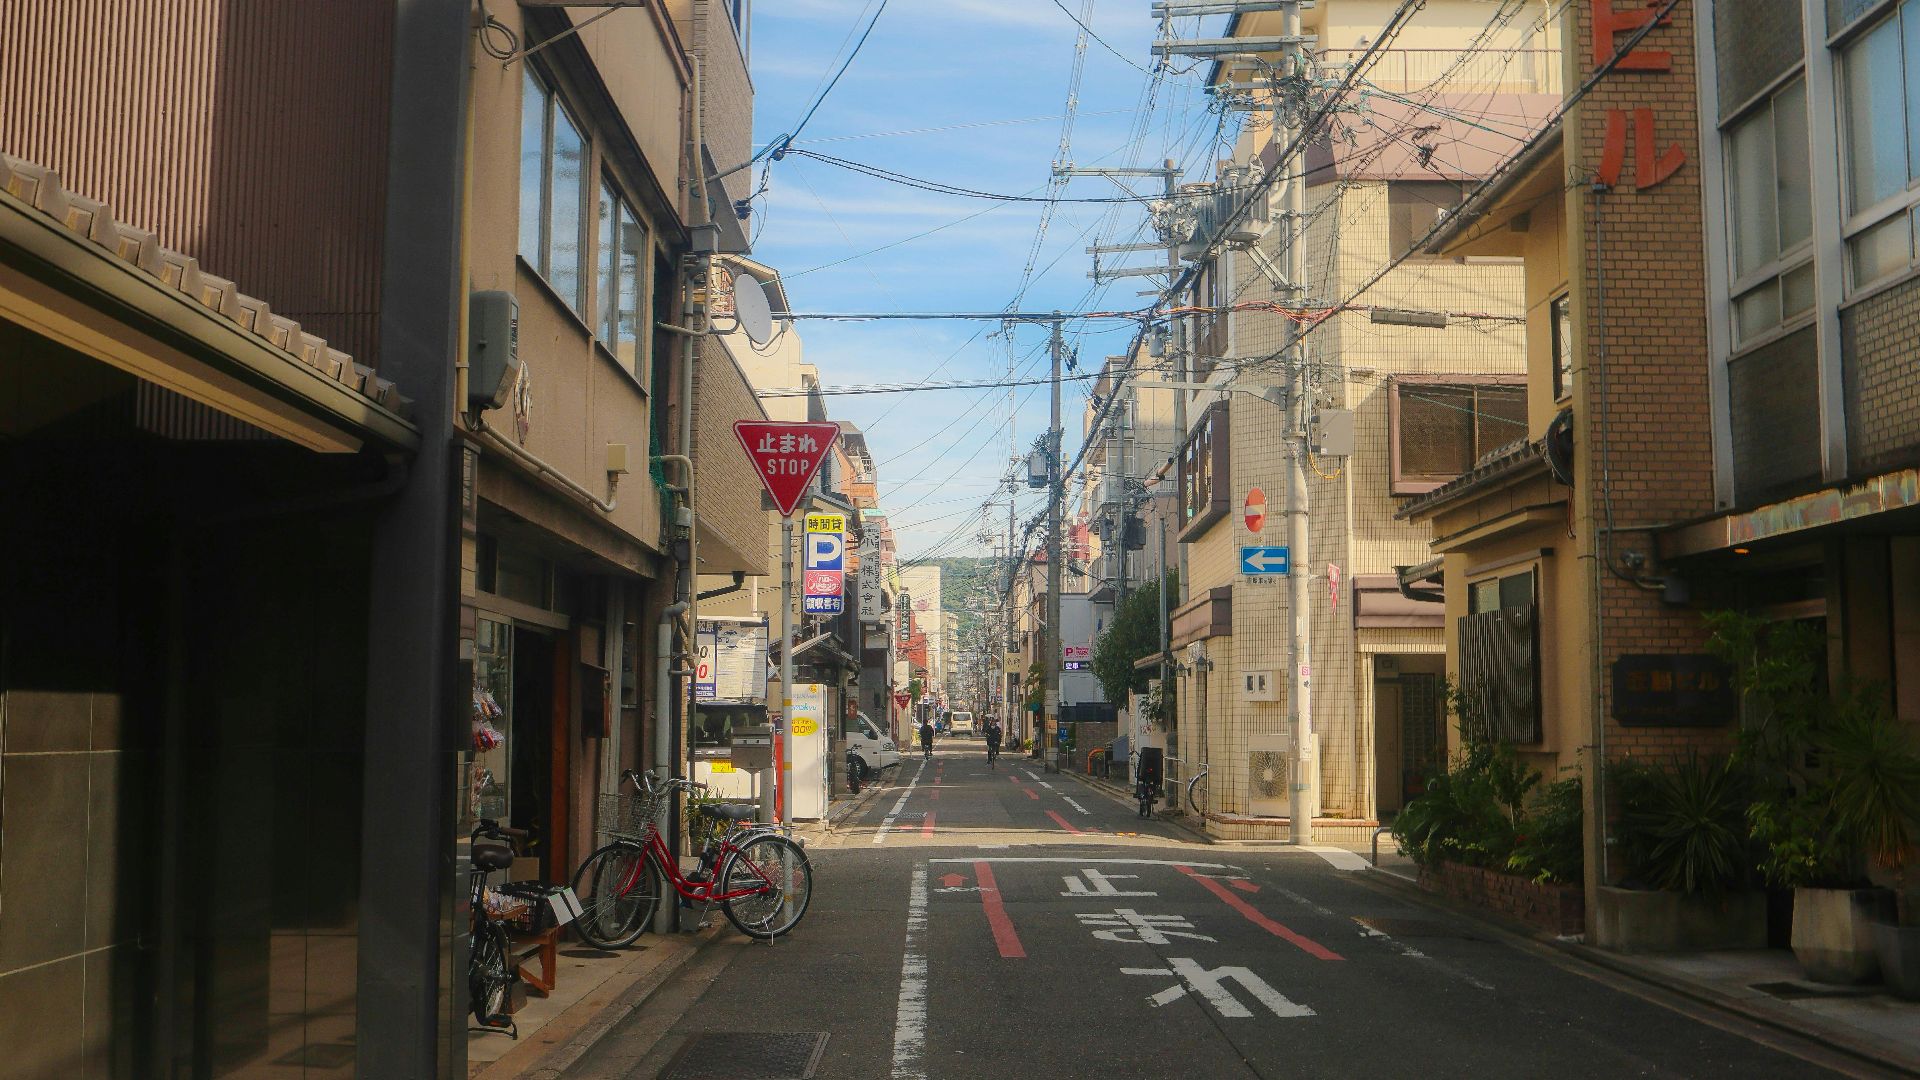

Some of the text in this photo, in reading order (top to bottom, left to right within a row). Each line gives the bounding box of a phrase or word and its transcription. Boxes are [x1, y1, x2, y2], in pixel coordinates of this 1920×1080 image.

[756, 432, 819, 454] 止まれ
[767, 459, 809, 476] STOP
[808, 518, 842, 531] 時間貸
[808, 534, 842, 568] P
[806, 597, 841, 610] 領収書有
[1065, 647, 1074, 657] P
[1060, 868, 1317, 1018] 止まれ
